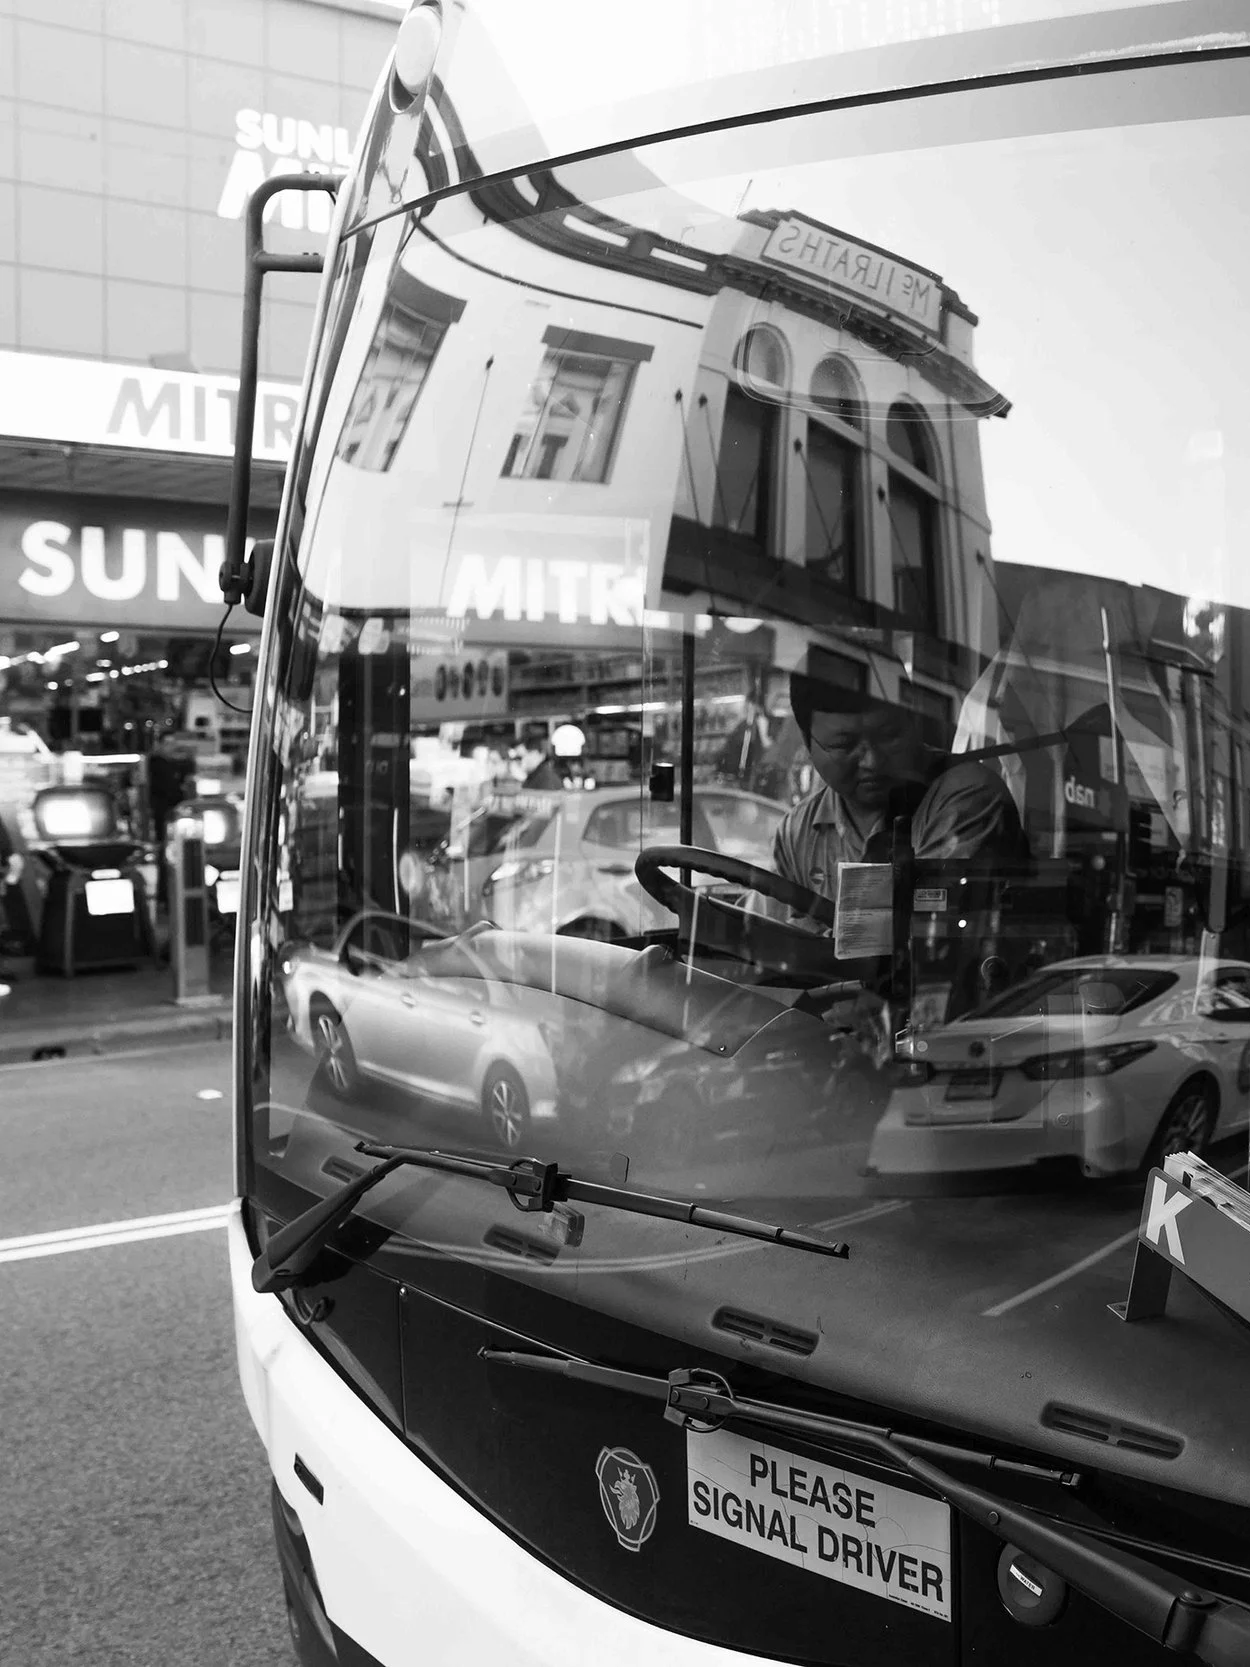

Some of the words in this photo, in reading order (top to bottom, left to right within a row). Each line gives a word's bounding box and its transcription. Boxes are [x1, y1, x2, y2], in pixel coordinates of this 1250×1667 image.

[217, 149, 350, 233] MI
[18, 520, 256, 606] SUN
[1146, 1175, 1193, 1266] K
[749, 1453, 876, 1529] PLEASE
[692, 1480, 808, 1554] SIGNAL
[817, 1525, 945, 1603] DRIVER
[1019, 1576, 1036, 1591] WATER
